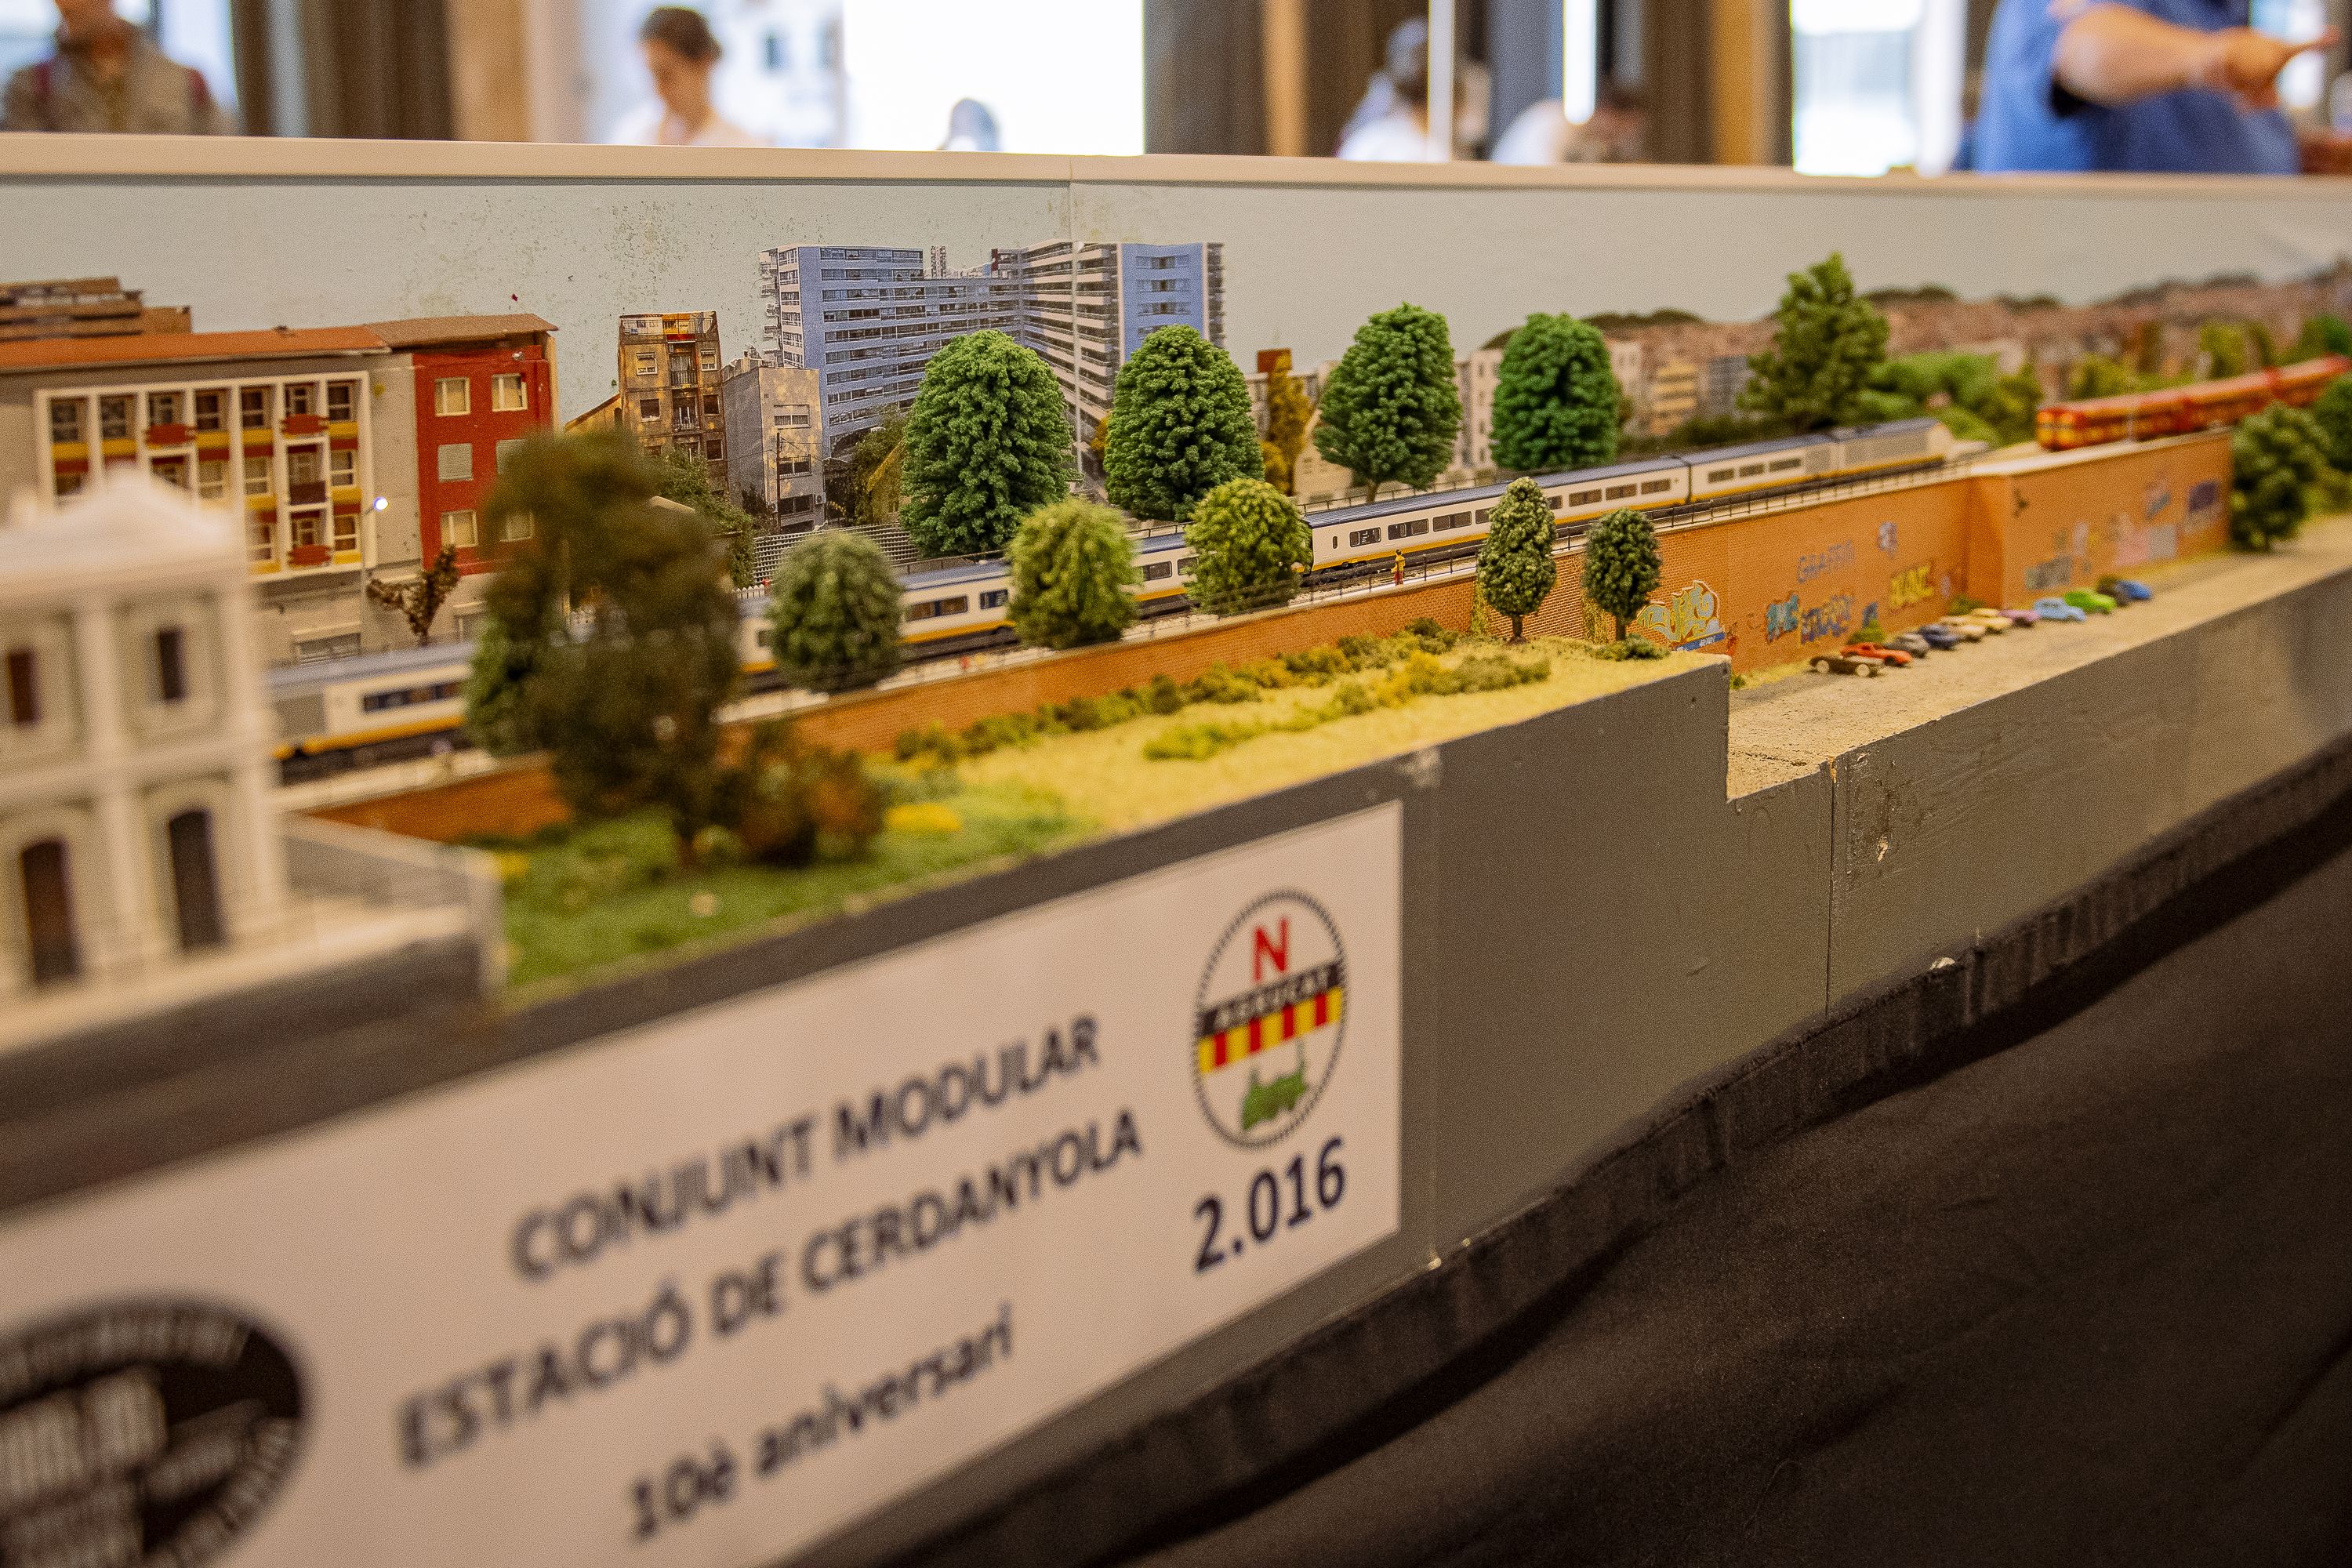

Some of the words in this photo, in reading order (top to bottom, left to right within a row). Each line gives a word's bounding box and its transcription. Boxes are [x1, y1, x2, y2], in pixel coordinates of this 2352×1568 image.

[1253, 916, 1291, 982] N
[510, 1116, 815, 1281] CONJUNT
[834, 1014, 1099, 1162] MODULAR
[1193, 1135, 1346, 1275] 2.016
[397, 1276, 691, 1468] ESTACIÓ
[710, 1252, 784, 1338] DE
[803, 1109, 1142, 1291] CERDANYOLA
[756, 1303, 1013, 1477] aniversari
